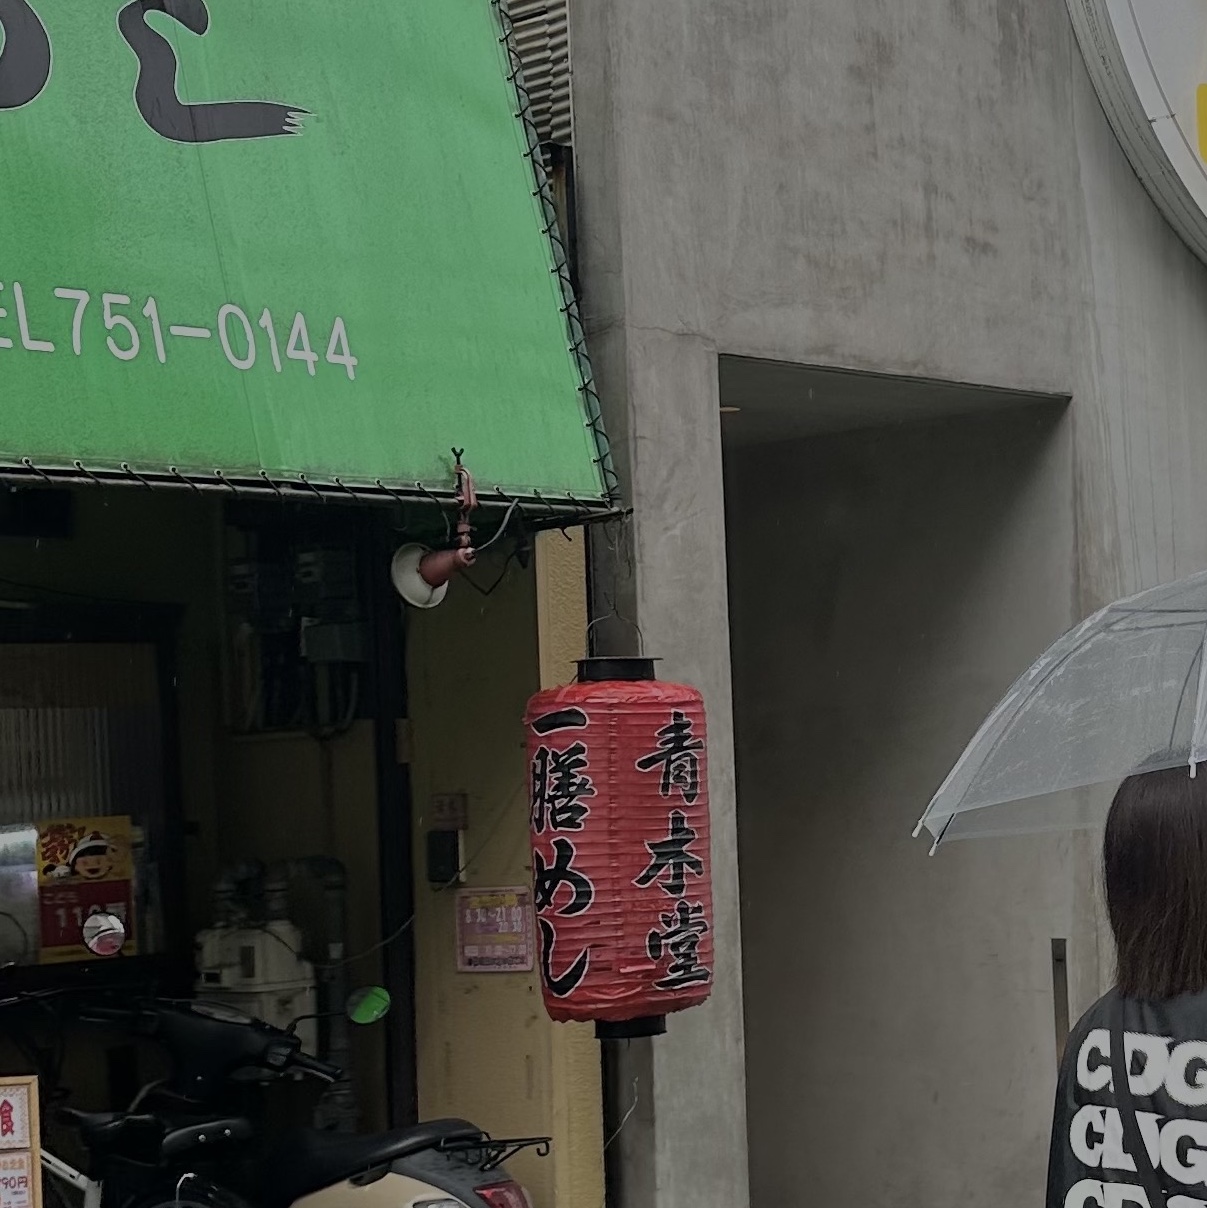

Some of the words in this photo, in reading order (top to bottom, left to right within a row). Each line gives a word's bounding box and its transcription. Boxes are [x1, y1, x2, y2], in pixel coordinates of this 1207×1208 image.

[531, 707, 597, 998] 一膳めし
[631, 708, 712, 990] 青木堂
[0, 1175, 28, 1190] 90円
